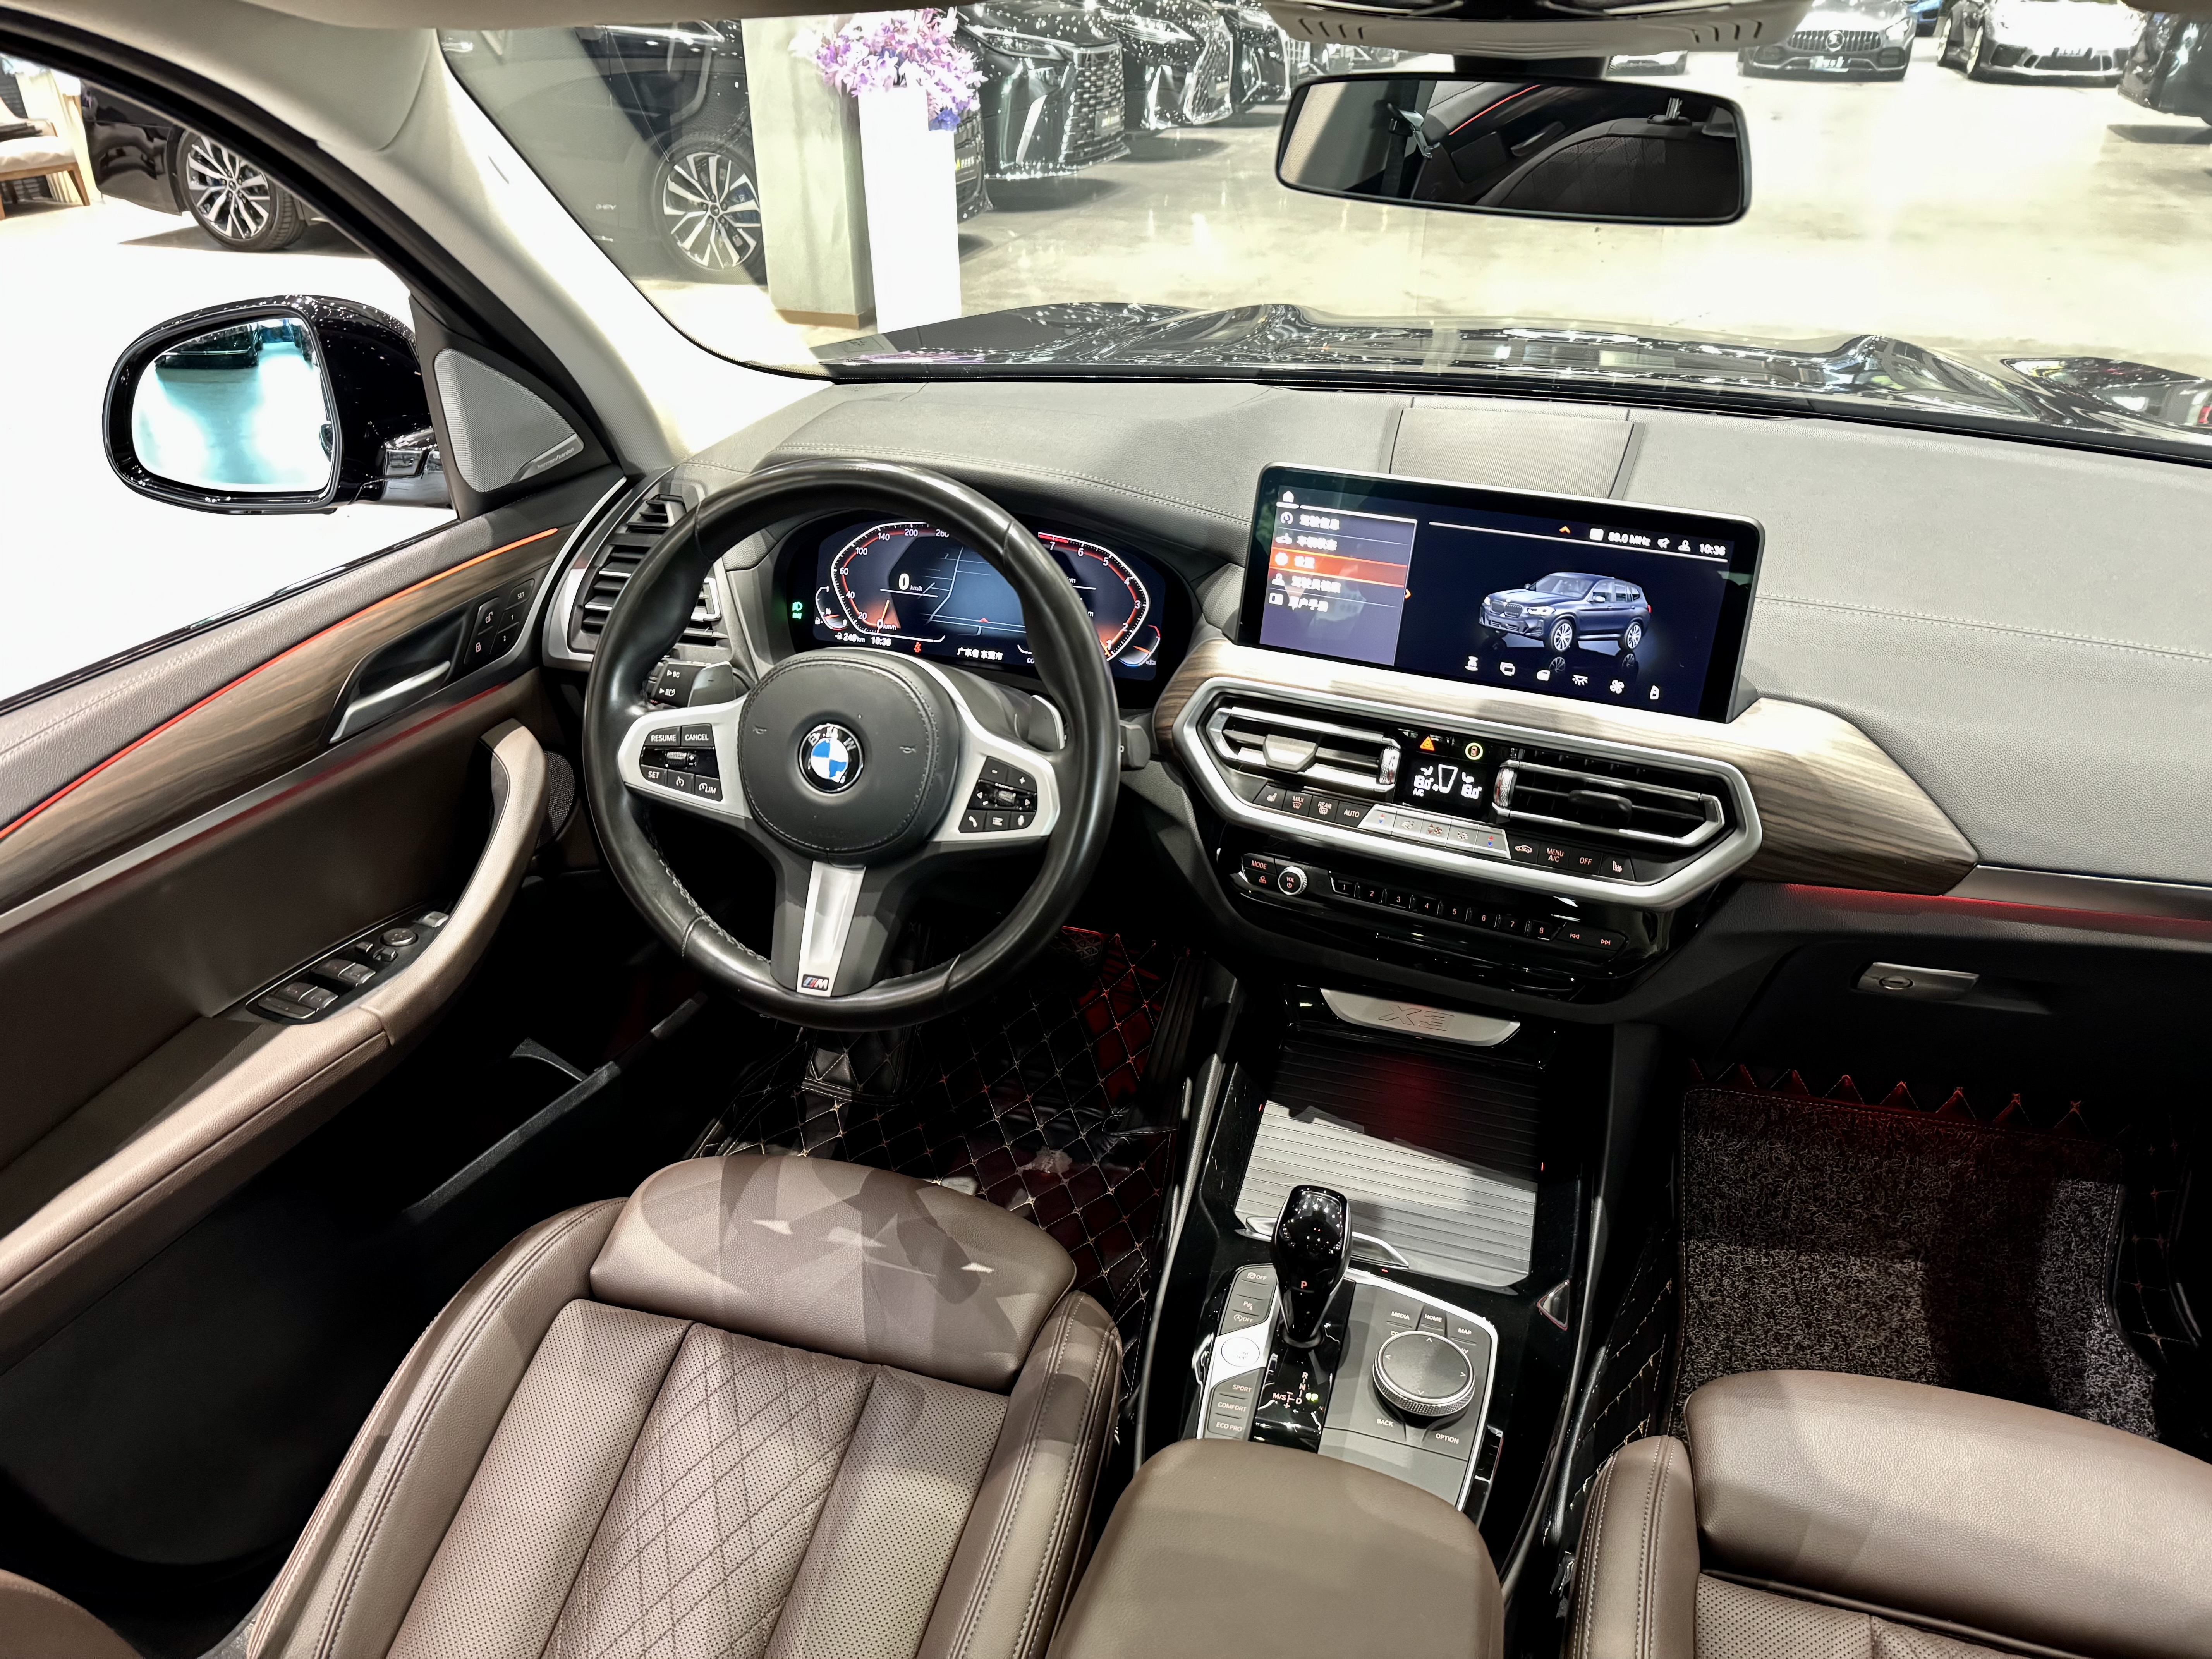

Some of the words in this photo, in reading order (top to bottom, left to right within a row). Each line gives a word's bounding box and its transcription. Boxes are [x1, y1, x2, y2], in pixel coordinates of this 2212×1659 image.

[878, 532, 890, 541] 140
[904, 529, 918, 537] 200
[1629, 534, 1651, 546] MHz
[1050, 542, 1055, 550] 7
[855, 547, 868, 555] 100
[1078, 548, 1084, 556] 6
[1103, 557, 1109, 566] 5
[899, 573, 910, 590] 0
[1124, 577, 1130, 586] 4
[1135, 600, 1141, 609] 3
[877, 619, 883, 629] 0
[1123, 623, 1128, 631] 2
[1106, 640, 1111, 650] 1
[1318, 801, 1332, 809] REAR
[1343, 809, 1360, 818] AUTO
[1546, 848, 1564, 857] MENU
[1251, 860, 1267, 870] MODE
[1579, 857, 1592, 865] OFF
[1378, 1005, 1454, 1031] X3
[1391, 1311, 1410, 1320] MEDIA
[1424, 1314, 1442, 1322] HOME
[1218, 1402, 1247, 1412] COMFORT
[1377, 1418, 1393, 1427] BACK
[1436, 1433, 1459, 1444] OPTION
